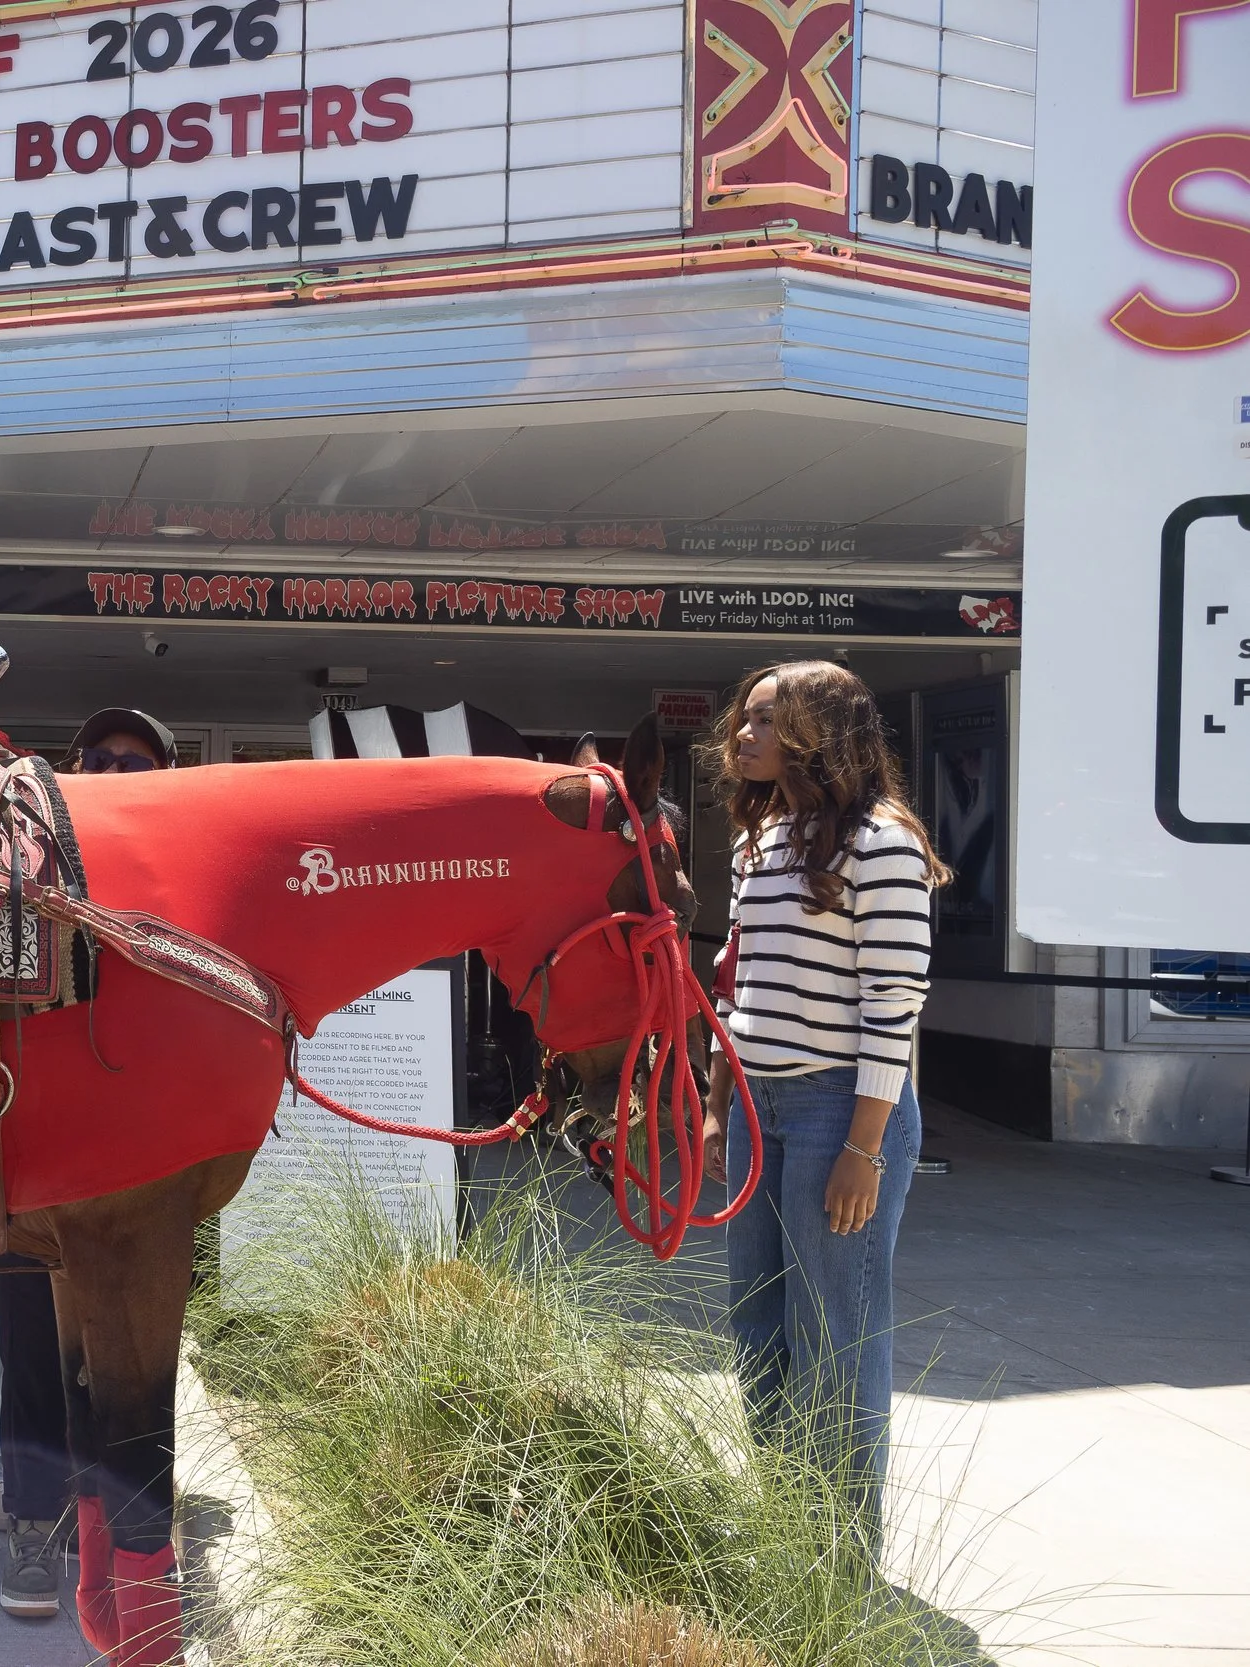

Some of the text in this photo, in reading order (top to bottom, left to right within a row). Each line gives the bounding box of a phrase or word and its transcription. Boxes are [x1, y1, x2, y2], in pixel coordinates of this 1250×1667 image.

[86, 0, 280, 83] 2026
[14, 77, 414, 183] BOOSTERS
[88, 572, 666, 628] THE ROCKY HORROR PICTURE SHOW
[679, 590, 854, 608] LIVE with LDOD, INC!
[682, 611, 854, 628] Every Friday Night at 11pm
[657, 703, 711, 717] PARKING
[339, 1004, 376, 1013] NSENT
[314, 1043, 348, 1051] CONSENT
[297, 1054, 331, 1062] ECORDED
[309, 1078, 335, 1086] FILMED
[336, 1079, 365, 1087] AND/OR
[366, 1080, 405, 1088] RECORDED
